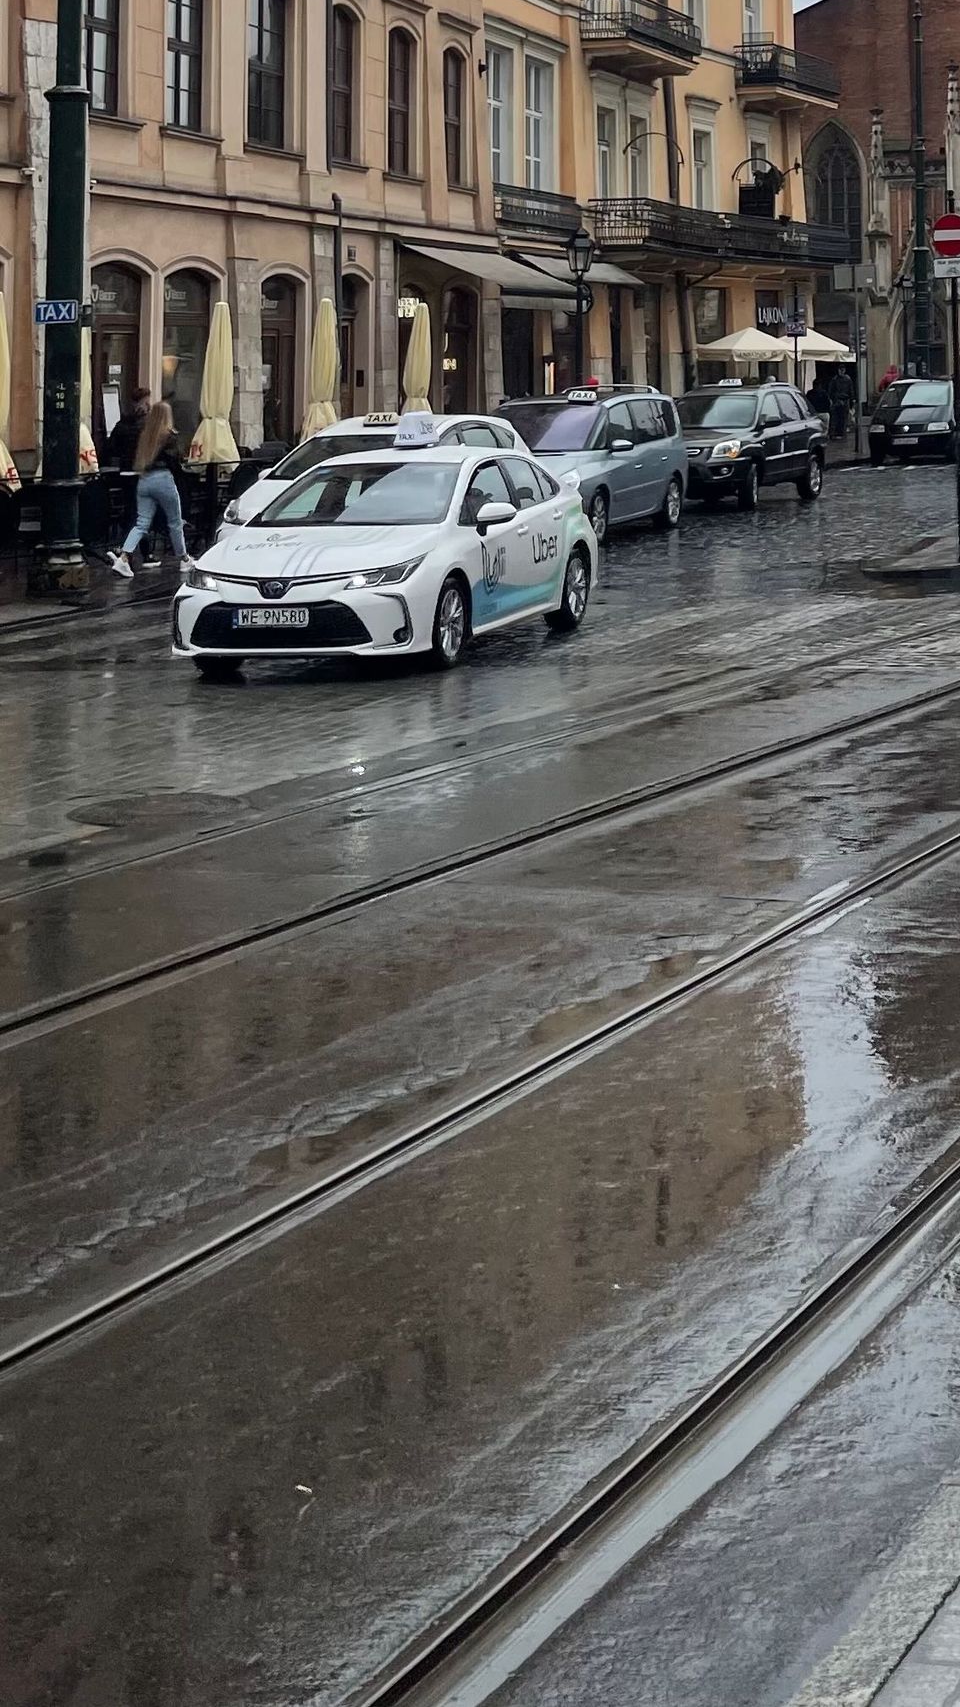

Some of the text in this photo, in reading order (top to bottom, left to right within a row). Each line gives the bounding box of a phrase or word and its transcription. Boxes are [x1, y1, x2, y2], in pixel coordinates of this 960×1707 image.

[37, 302, 76, 322] TAXI
[571, 391, 594, 399] TAXI
[367, 414, 394, 423] TAXI
[531, 532, 558, 565] Uber
[241, 610, 259, 624] WE
